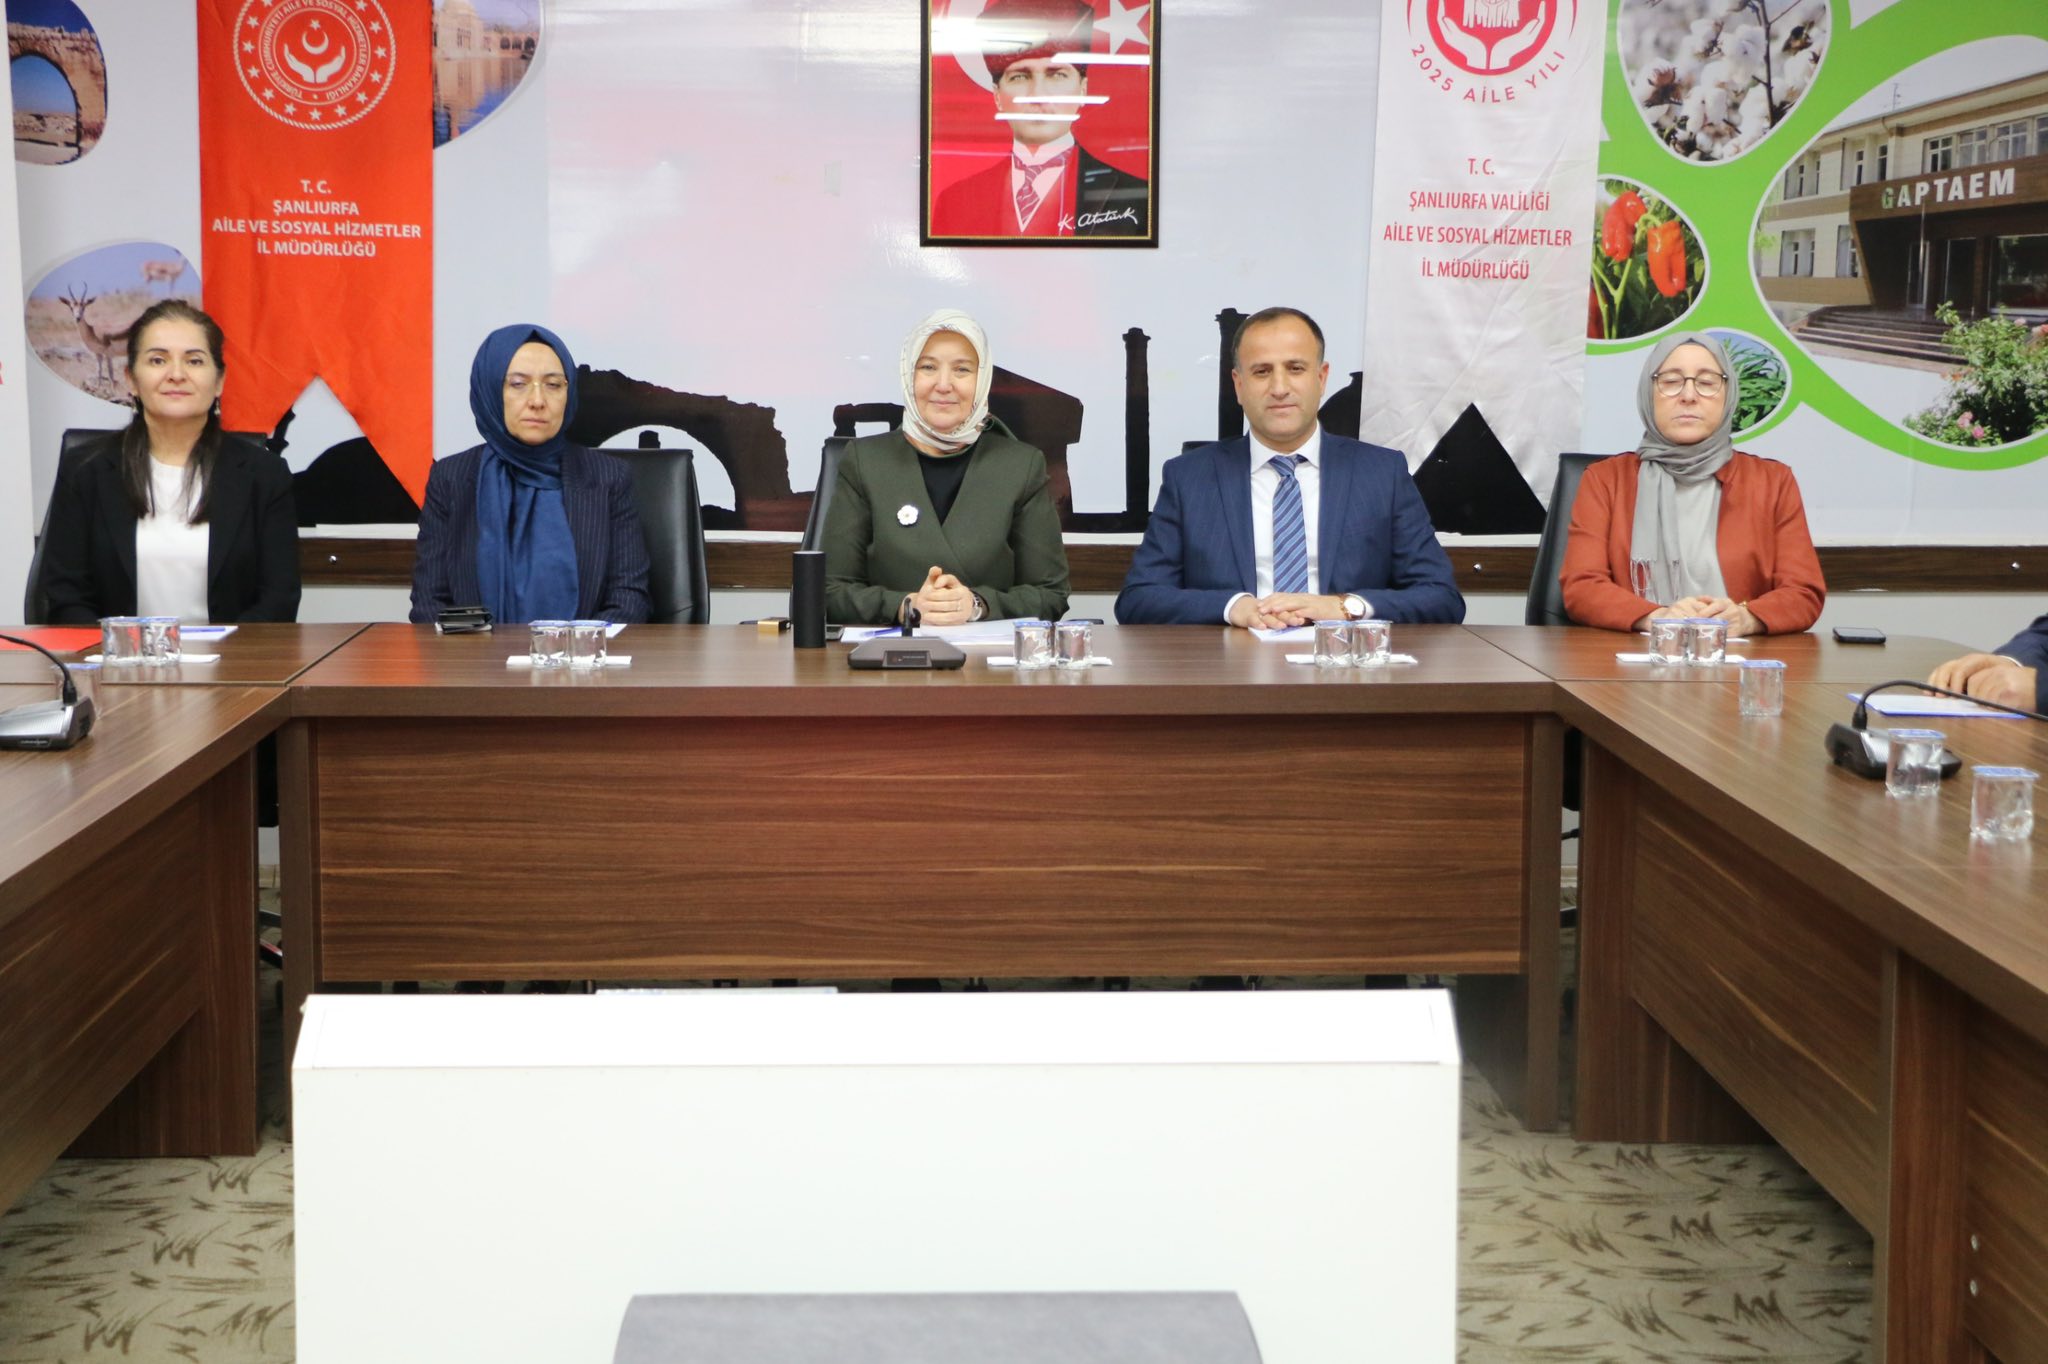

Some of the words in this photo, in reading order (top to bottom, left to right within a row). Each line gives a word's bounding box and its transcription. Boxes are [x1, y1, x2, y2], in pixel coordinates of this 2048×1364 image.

[1411, 44, 1454, 91] 2025
[1463, 86, 1515, 103] AİLE
[1525, 51, 1565, 89] YILI
[1467, 158, 1479, 175] T.
[1482, 158, 1495, 175] C.
[300, 180, 314, 194] T.
[316, 180, 332, 194] C.
[1881, 167, 2015, 209] GAPTAEM
[273, 200, 360, 216] ŞANLIURFA
[1409, 191, 1487, 212] ŞANLIURFA
[1491, 191, 1551, 211] VALİLİĞİ
[212, 216, 246, 232] AİLE
[249, 219, 268, 233] VE
[271, 221, 331, 235] SOSYAL
[334, 220, 422, 238] HİZMETLER
[1383, 221, 1414, 242] AİLE
[1417, 225, 1434, 243] VE
[1437, 226, 1489, 245] SOSYAL
[1493, 225, 1572, 246] HİZMETLER
[257, 238, 271, 254] İL
[274, 239, 376, 257] MÜDÜRLÜĞÜ
[1422, 257, 1434, 277] İL
[1437, 258, 1530, 280] MÜDÜRLÜĞÜ
